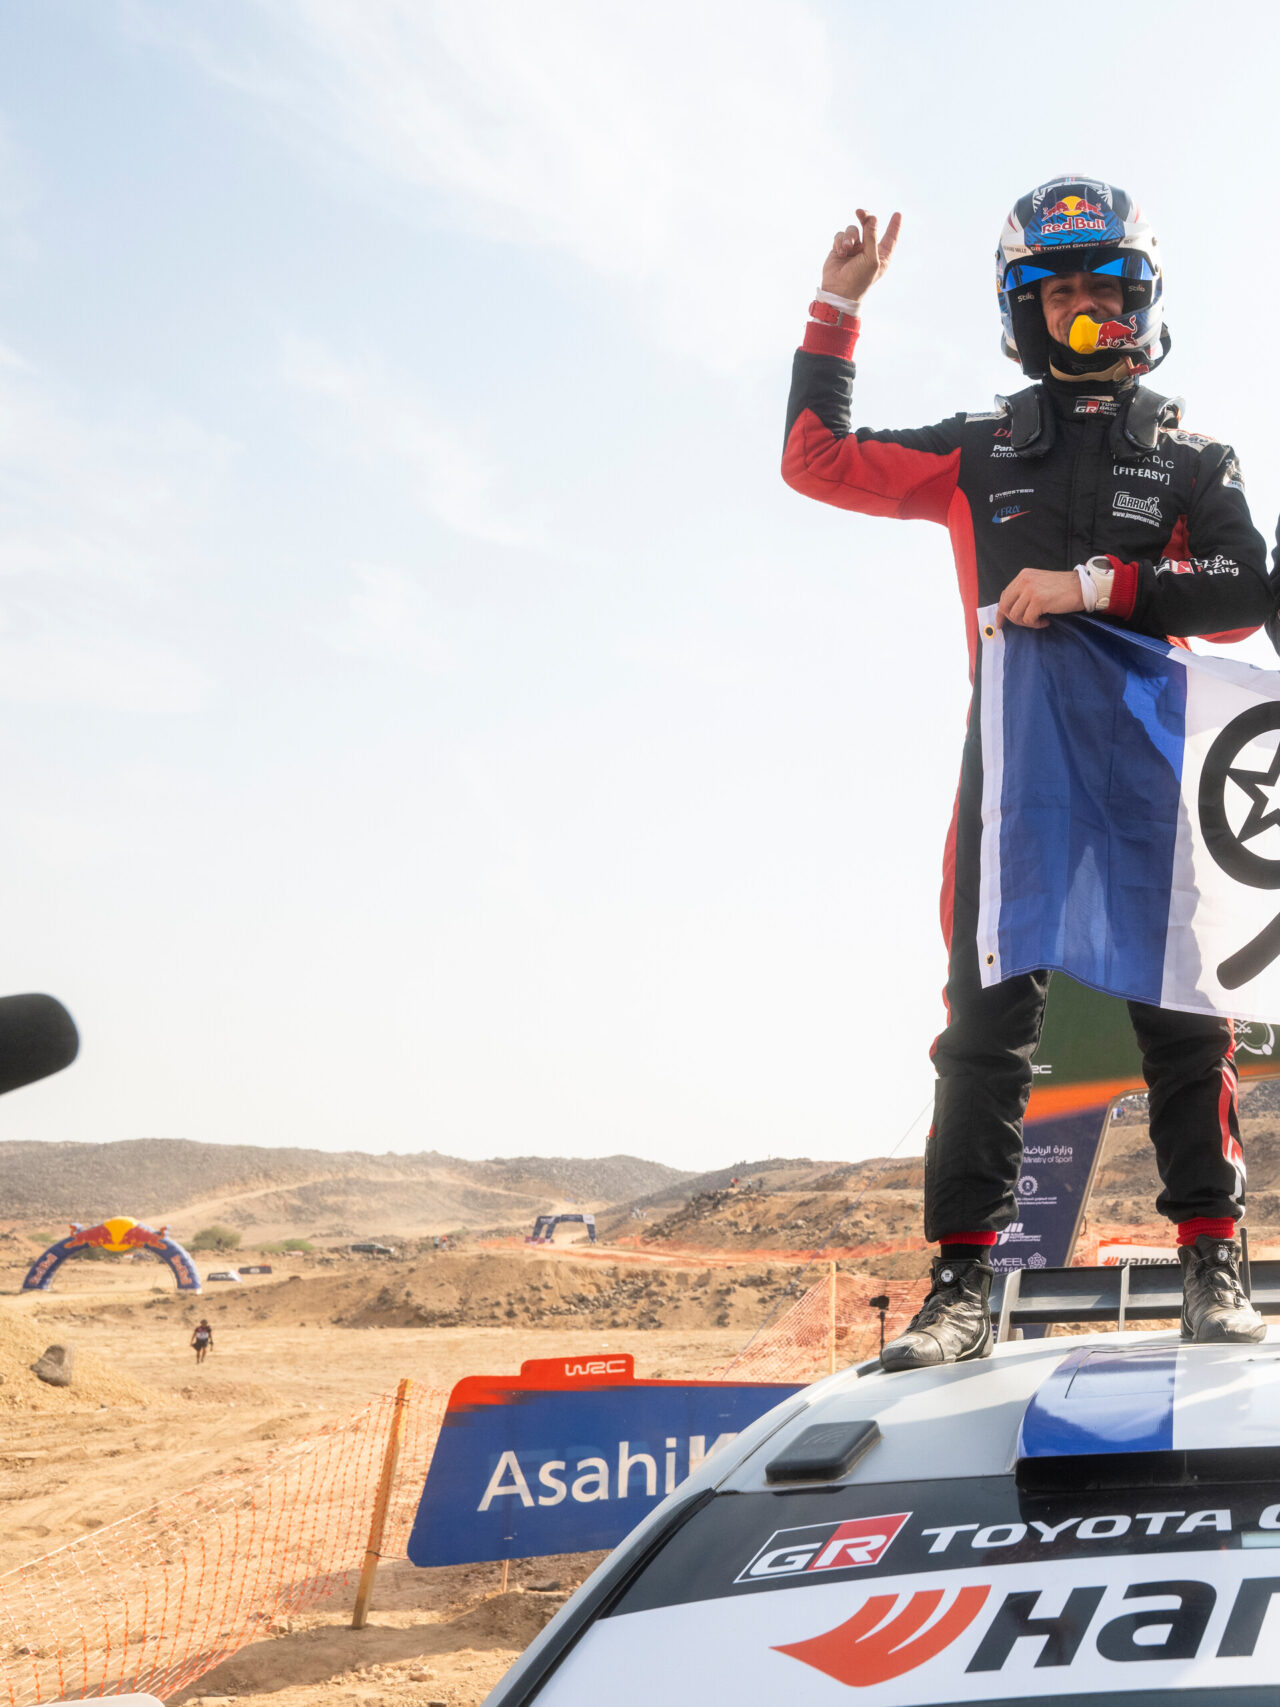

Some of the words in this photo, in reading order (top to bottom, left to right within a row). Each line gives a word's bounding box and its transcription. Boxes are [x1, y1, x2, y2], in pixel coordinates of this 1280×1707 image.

[1041, 217, 1073, 235] Red
[1073, 216, 1106, 230] Bull
[1031, 1064, 1052, 1074] RC
[988, 1257, 1027, 1267] AMEEL
[565, 1360, 626, 1377] WRC
[477, 1432, 739, 1512] Asahi
[748, 1533, 888, 1577] GR
[921, 1508, 1234, 1555] TOYOTA
